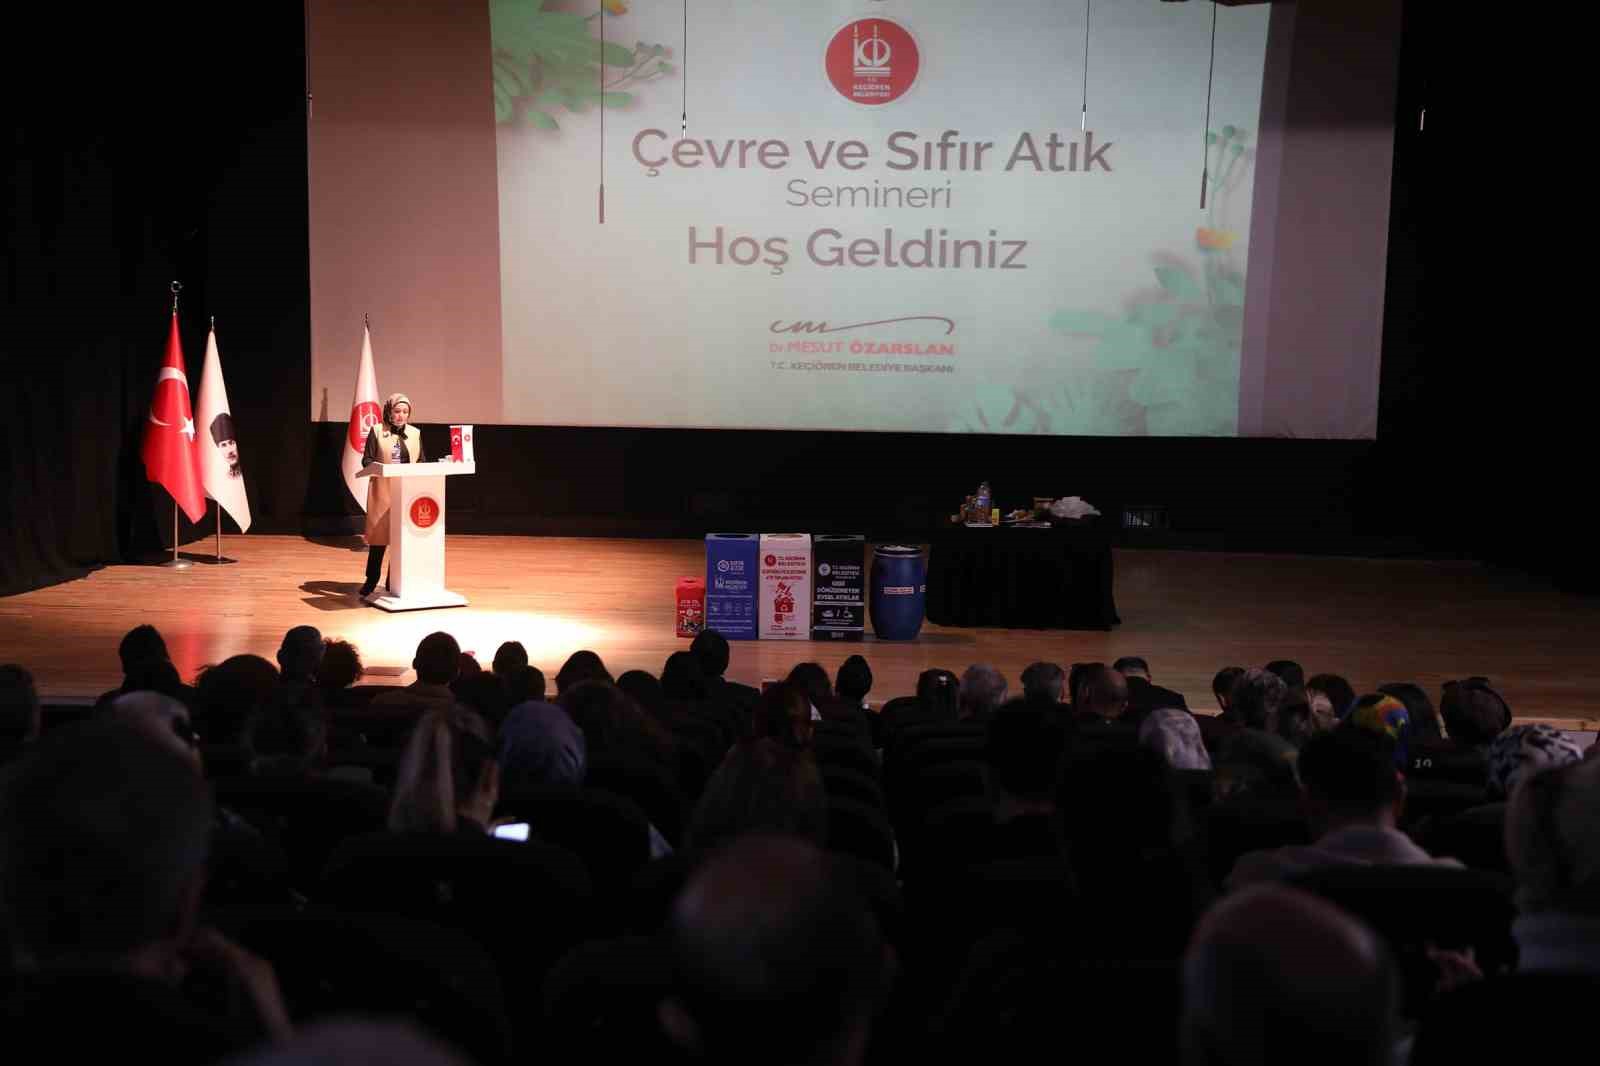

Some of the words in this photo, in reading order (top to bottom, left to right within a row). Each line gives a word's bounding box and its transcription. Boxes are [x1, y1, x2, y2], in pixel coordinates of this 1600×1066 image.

[632, 129, 790, 177] Çevre
[804, 139, 869, 170] ve
[886, 130, 994, 172] Sıfır
[1004, 131, 1113, 173] Atık
[786, 179, 952, 208] Semineri
[688, 226, 789, 275] Hoş
[806, 228, 1028, 269] Geldiniz
[788, 341, 843, 353] MESUT
[849, 339, 955, 355] ÖZARSLAN
